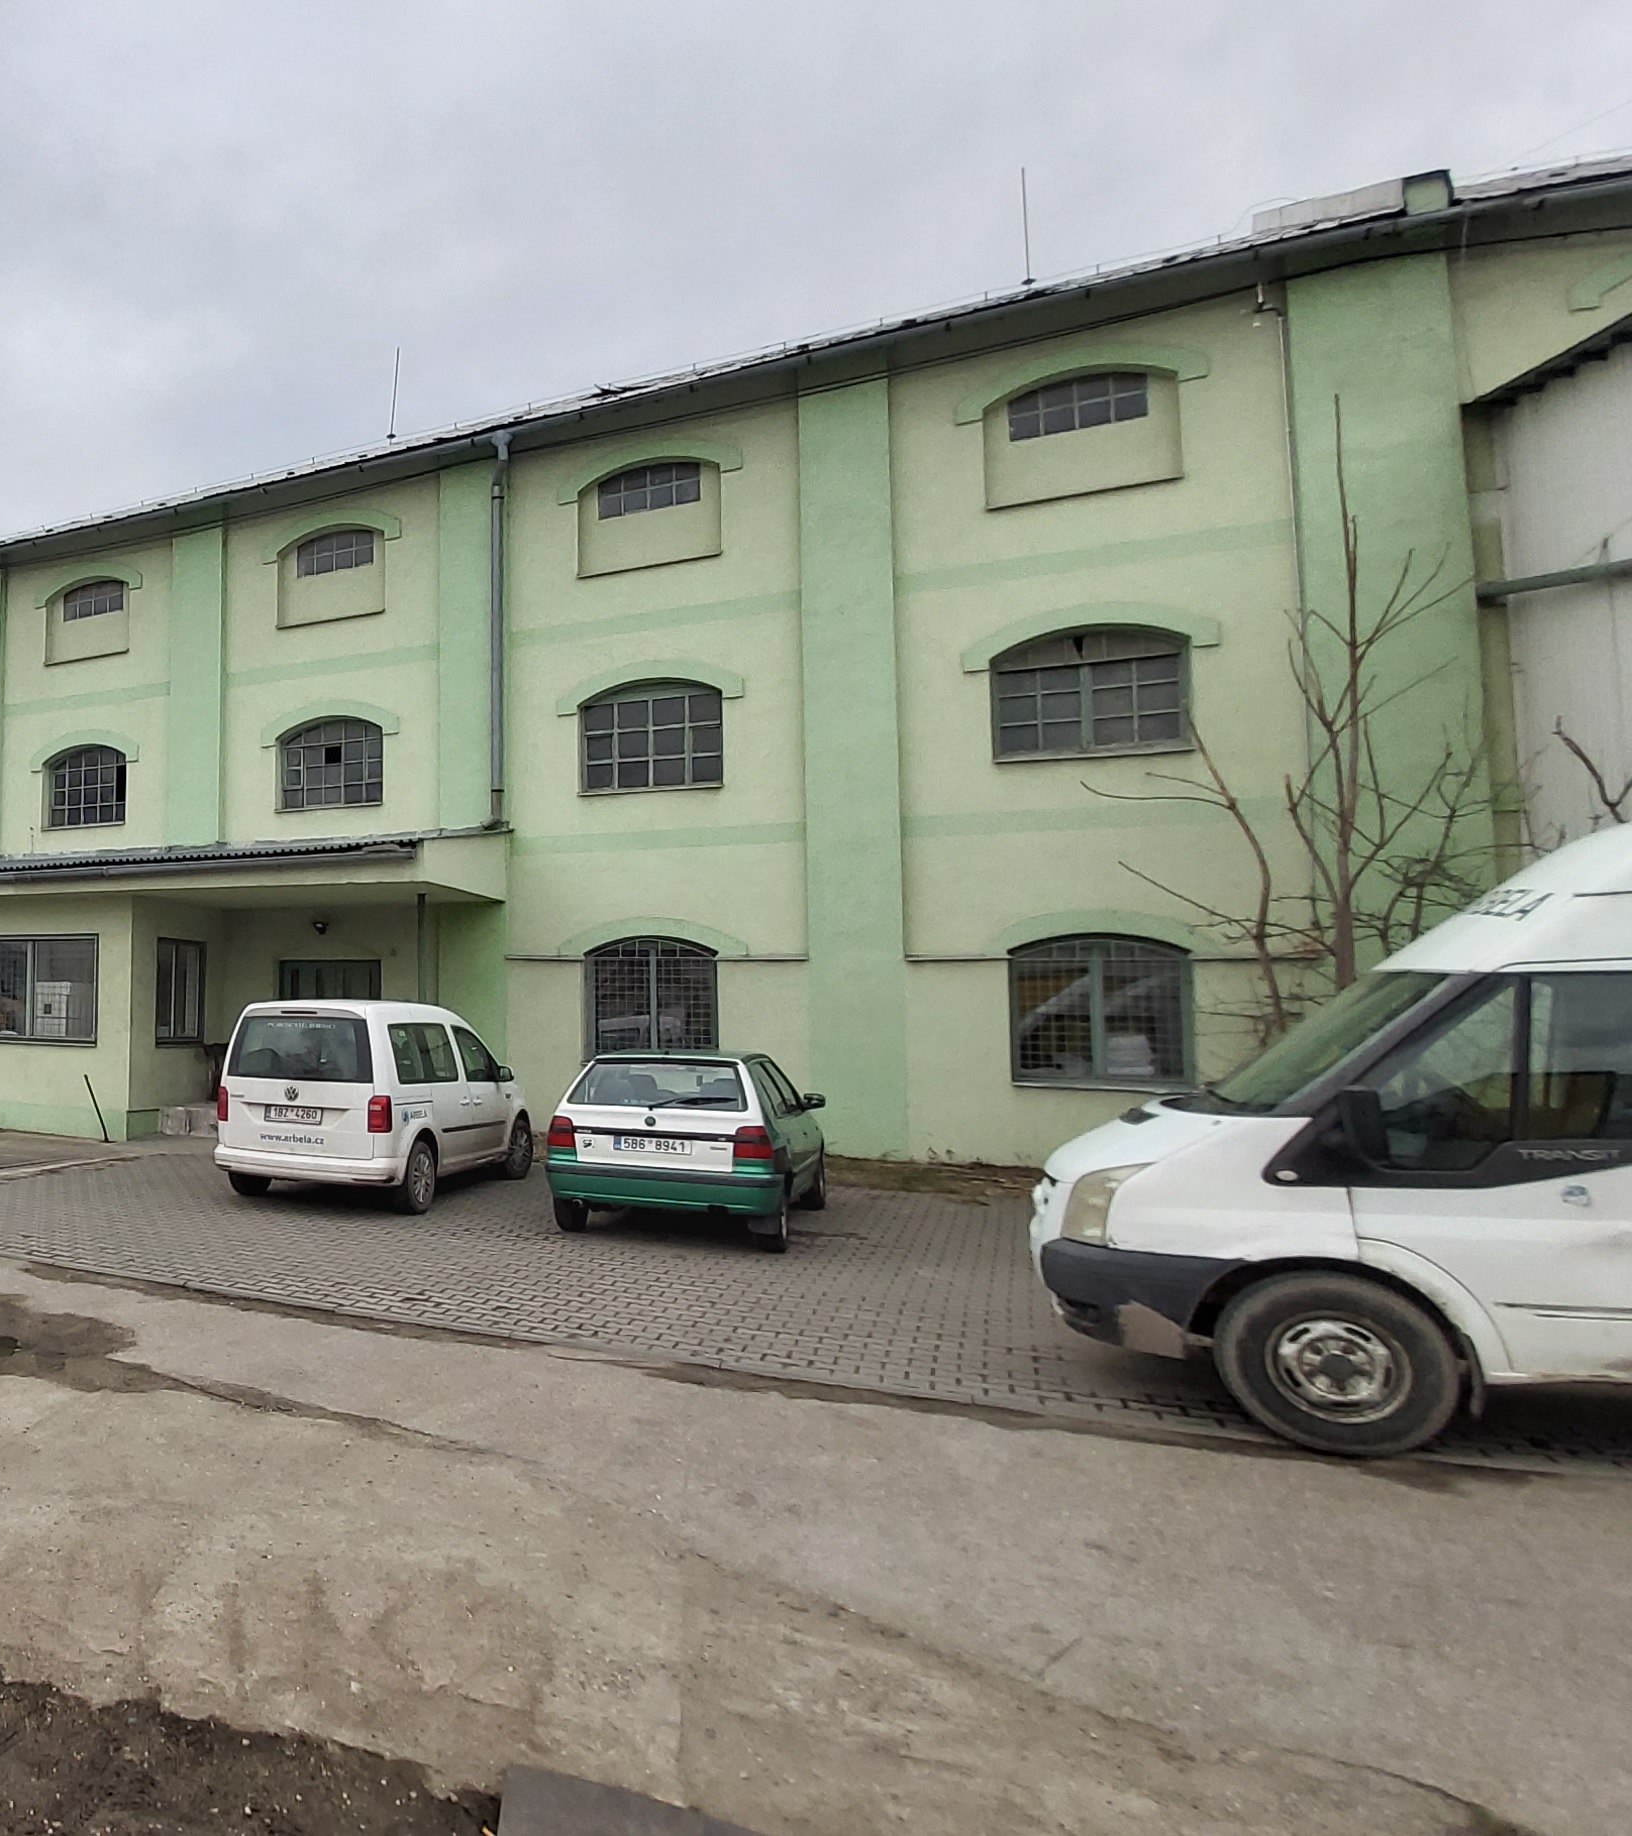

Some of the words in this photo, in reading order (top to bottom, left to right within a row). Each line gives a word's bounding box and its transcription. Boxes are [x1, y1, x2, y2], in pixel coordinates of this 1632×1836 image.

[295, 1109, 318, 1120] 4260
[260, 1133, 325, 1145] www.arbela.cz
[623, 1137, 646, 1150] 5B6
[655, 1139, 686, 1153] 8941
[1517, 1149, 1622, 1161] TRANSIT
